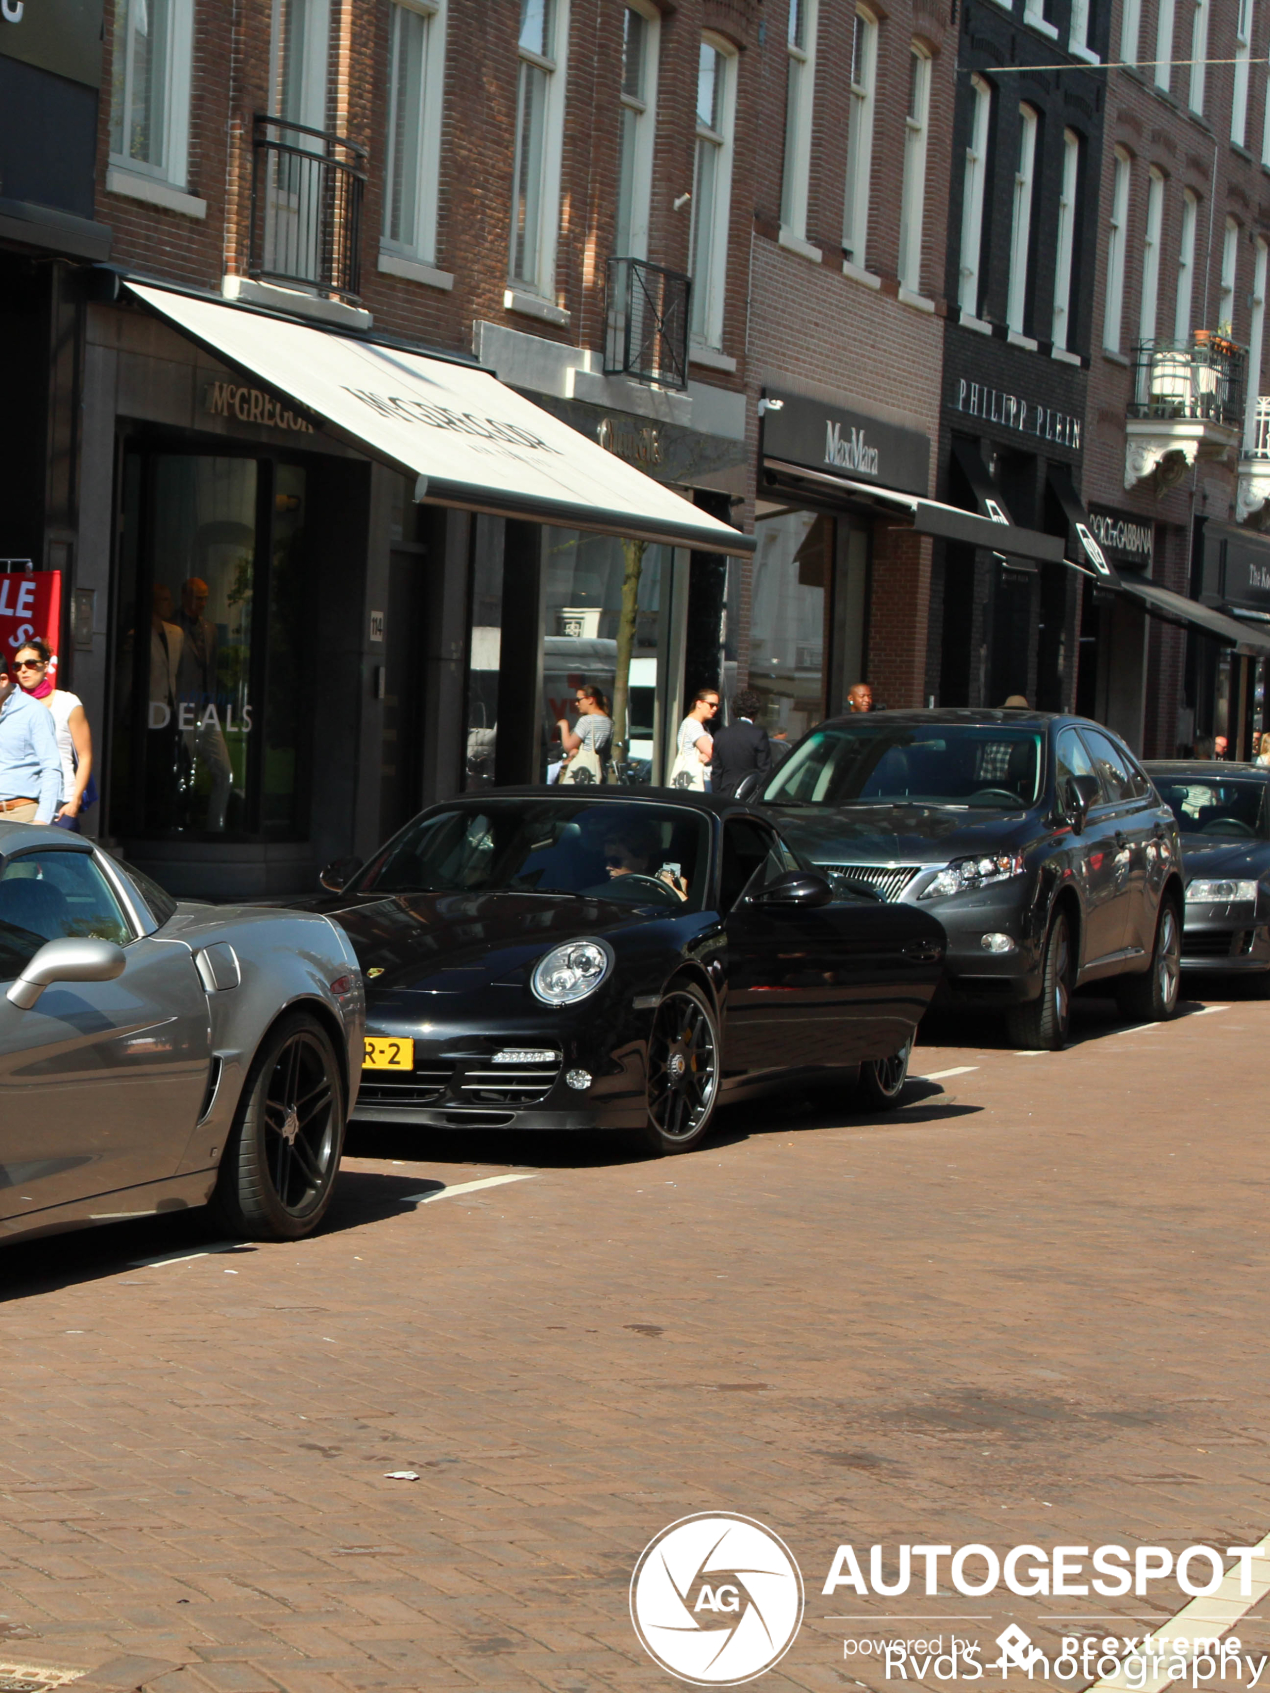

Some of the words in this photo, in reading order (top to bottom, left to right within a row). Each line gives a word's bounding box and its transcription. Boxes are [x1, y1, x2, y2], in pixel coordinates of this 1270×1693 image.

[959, 377, 1027, 431] PHILIPP
[1036, 404, 1081, 450] PLEIN
[824, 419, 879, 475] MaxMara
[371, 616, 383, 636] 114
[147, 701, 253, 733] DEALS
